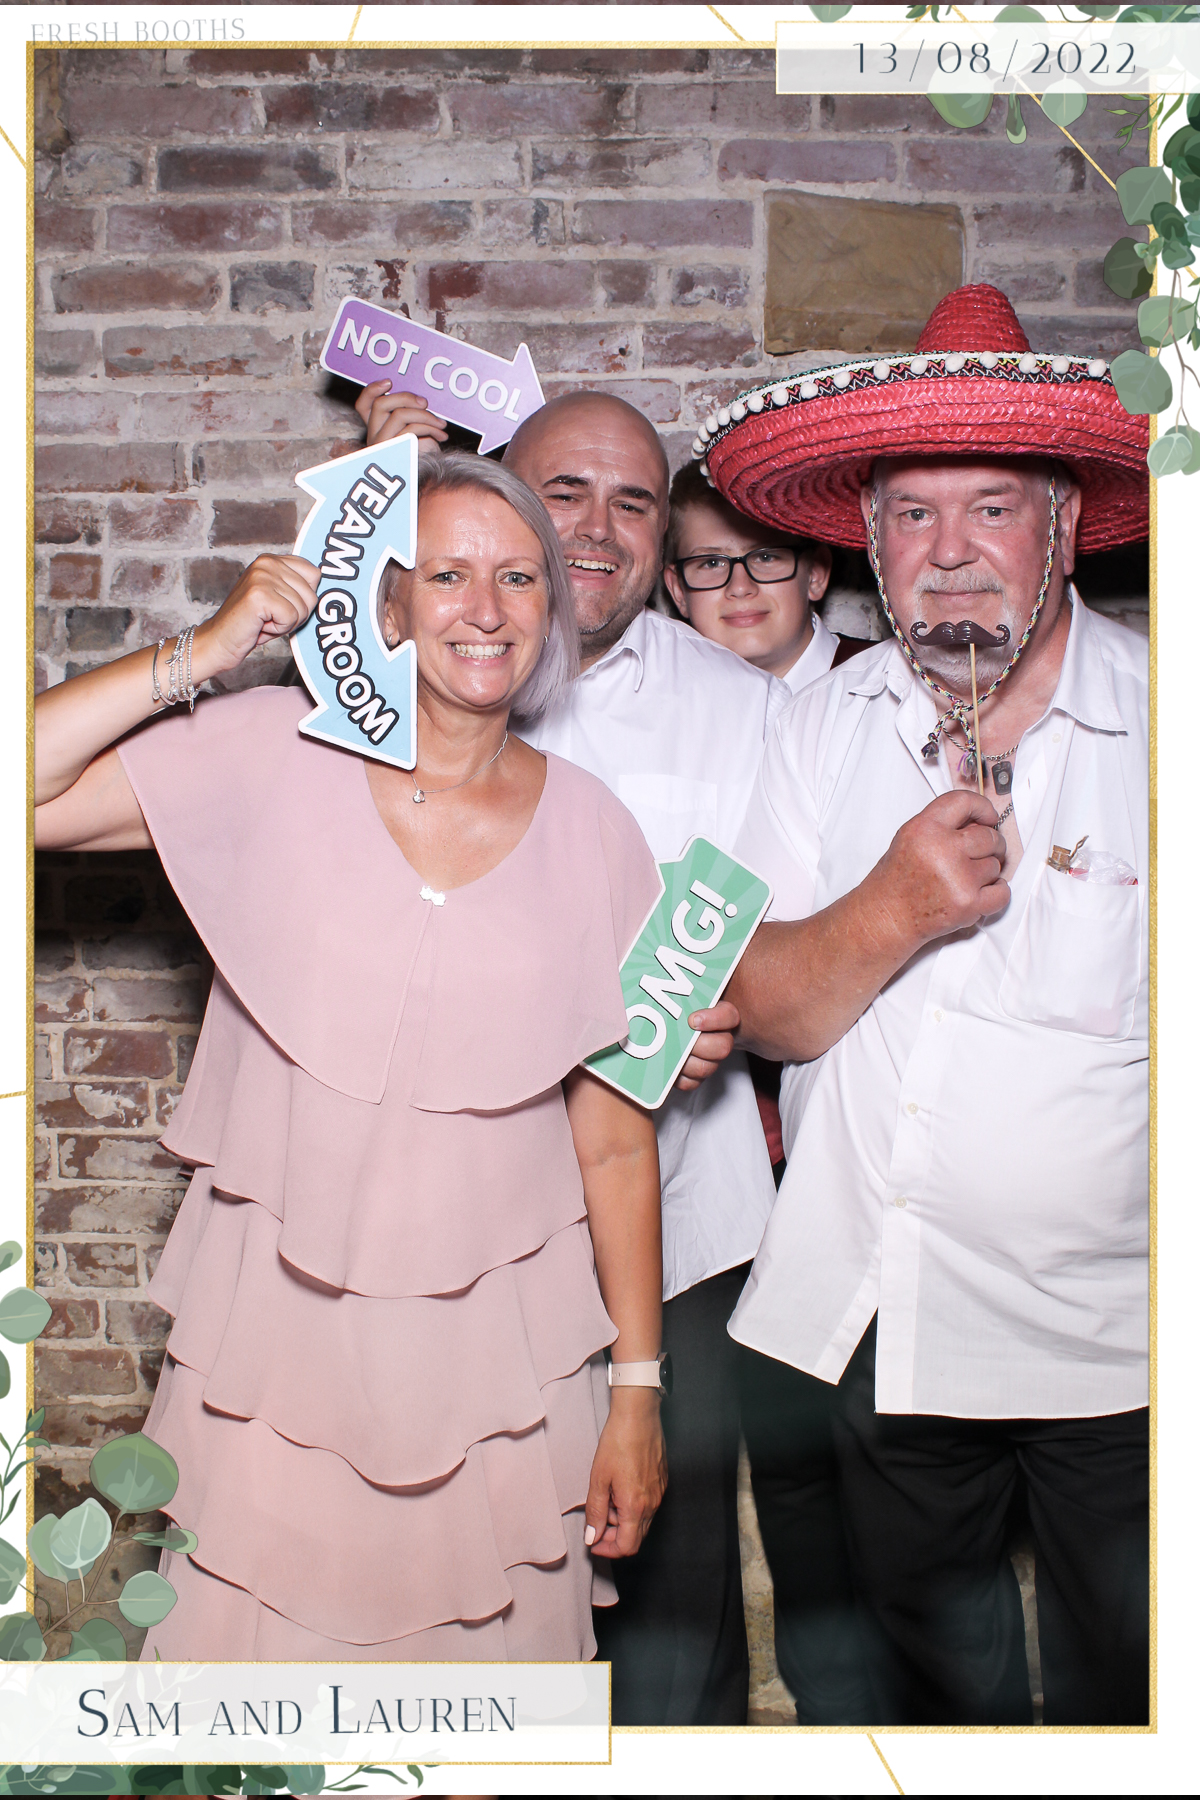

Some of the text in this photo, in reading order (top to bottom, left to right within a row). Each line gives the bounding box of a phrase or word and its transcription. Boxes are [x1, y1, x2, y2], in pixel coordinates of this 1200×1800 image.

[337, 317, 522, 422] NOT COOL
[315, 462, 406, 746] TEAM GROOM
[617, 879, 738, 1060] OMG!
